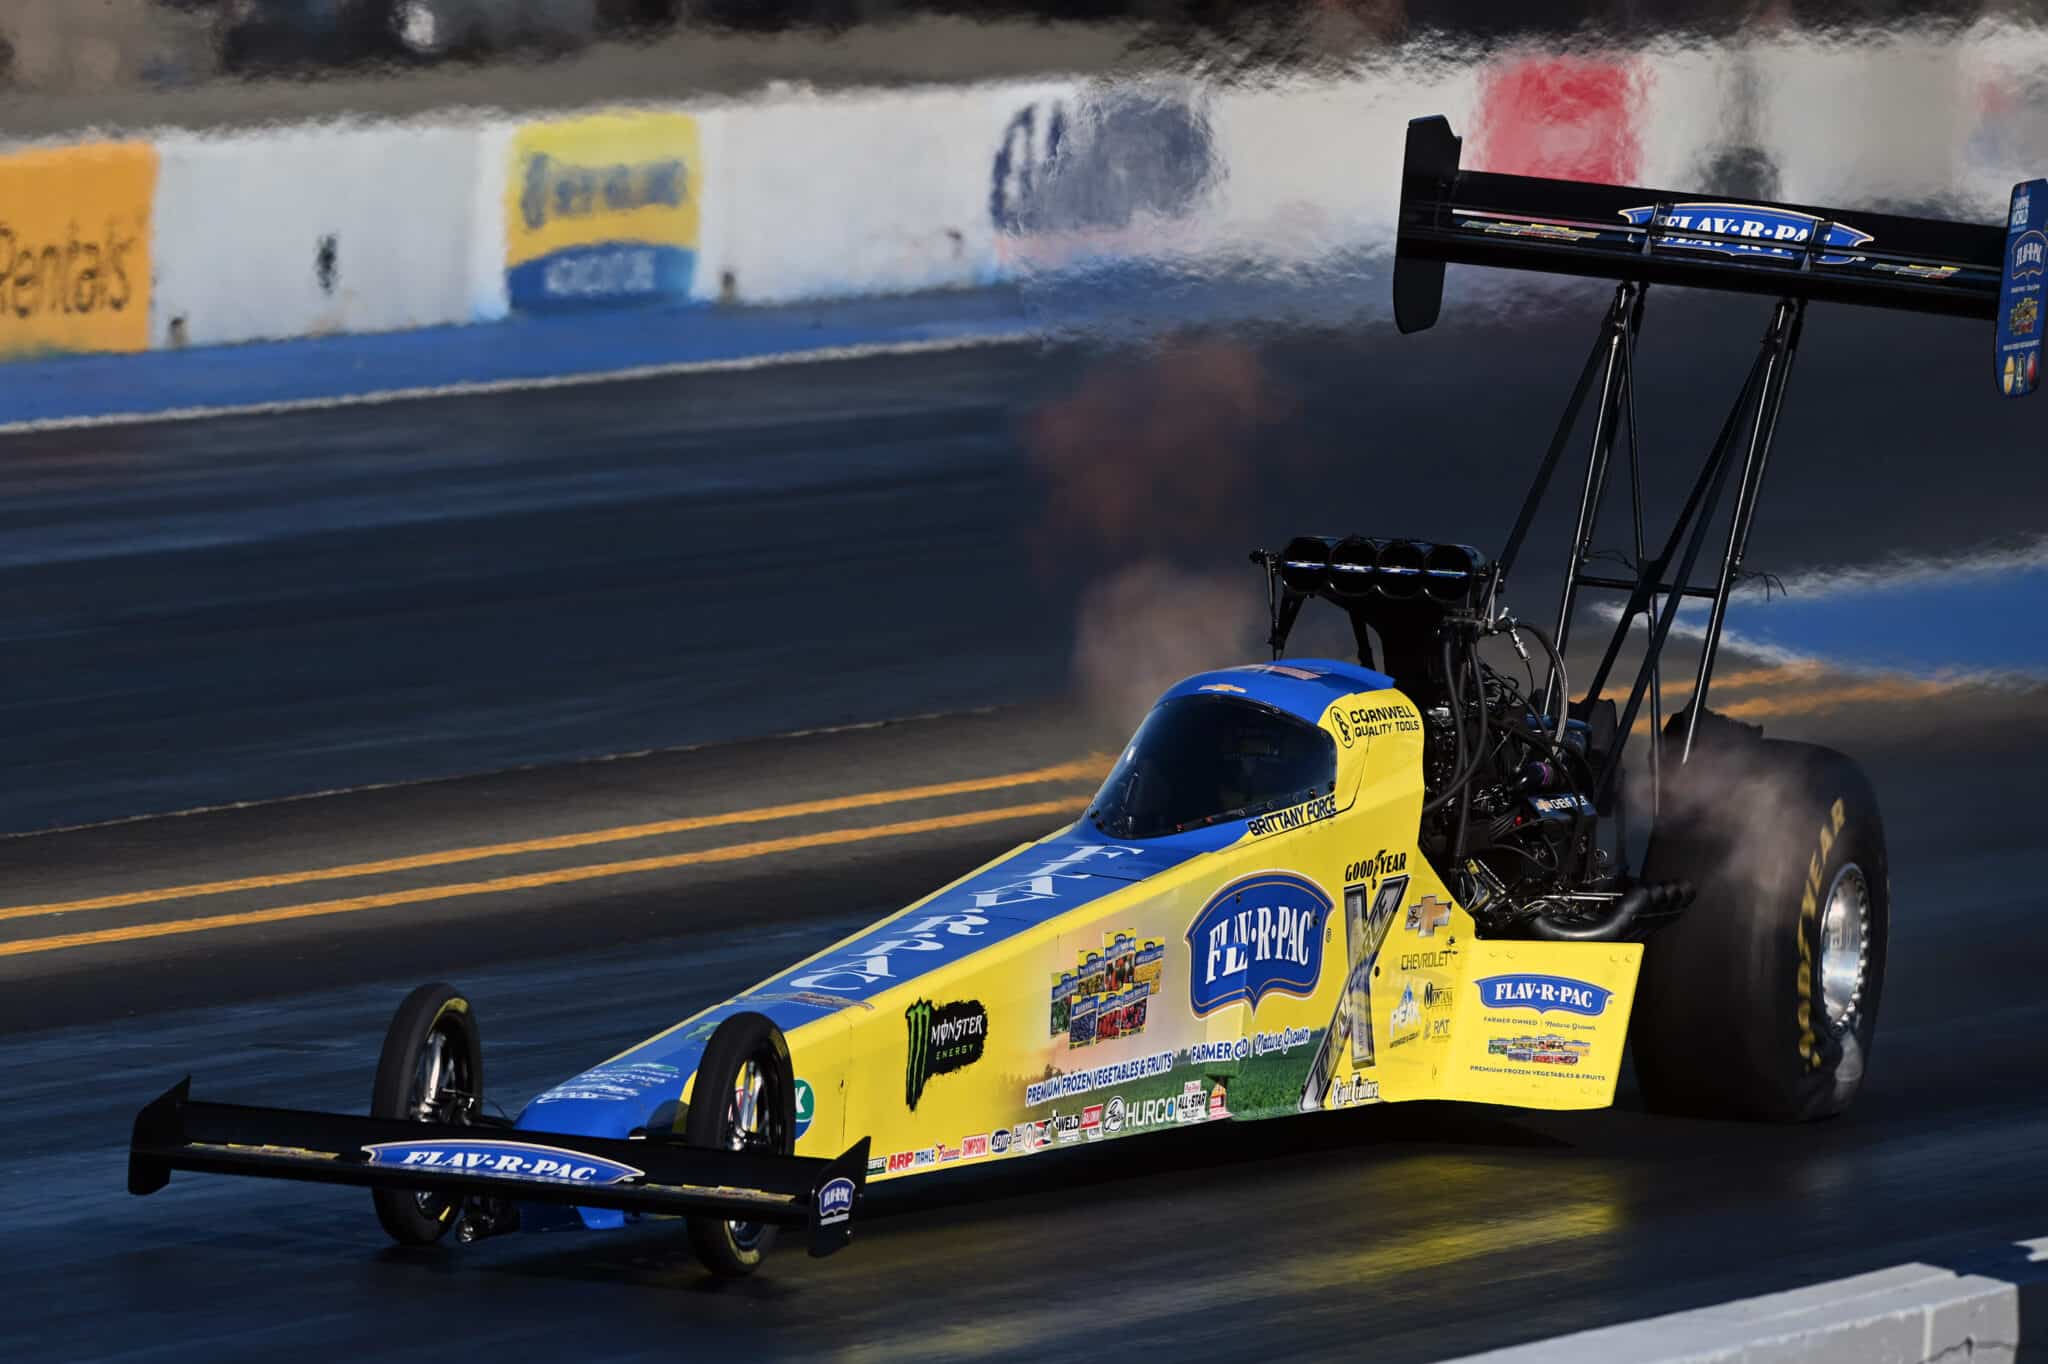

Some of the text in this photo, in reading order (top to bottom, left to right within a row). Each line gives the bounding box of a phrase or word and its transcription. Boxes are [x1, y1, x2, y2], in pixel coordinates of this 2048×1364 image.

[1350, 705, 1415, 724] CORNWELL
[1355, 720, 1420, 737] QUALITY TOOLS
[1247, 794, 1337, 837] BRITTANY FORCE
[1345, 851, 1407, 884] GOODYEAR
[1401, 951, 1449, 971] CHEVROLET
[931, 1014, 983, 1047] MONSTER
[1483, 1016, 1538, 1026] FARMER OWNED
[936, 1044, 974, 1060] ENERGY
[1192, 1042, 1232, 1062] FARMER
[1026, 1051, 1173, 1105] PREMIUM FROZEN VEGETABLES & FRUITS
[1469, 1065, 1503, 1073] PREMIUM
[1503, 1067, 1532, 1075] FROZEN
[1532, 1070, 1575, 1079] VEGETABLES
[1125, 1097, 1176, 1128] HURCO
[1058, 1115, 1080, 1132] WELD
[963, 1136, 987, 1157] SIMPSON
[888, 1151, 914, 1171] ARP
[914, 1149, 935, 1167] MAHLE
